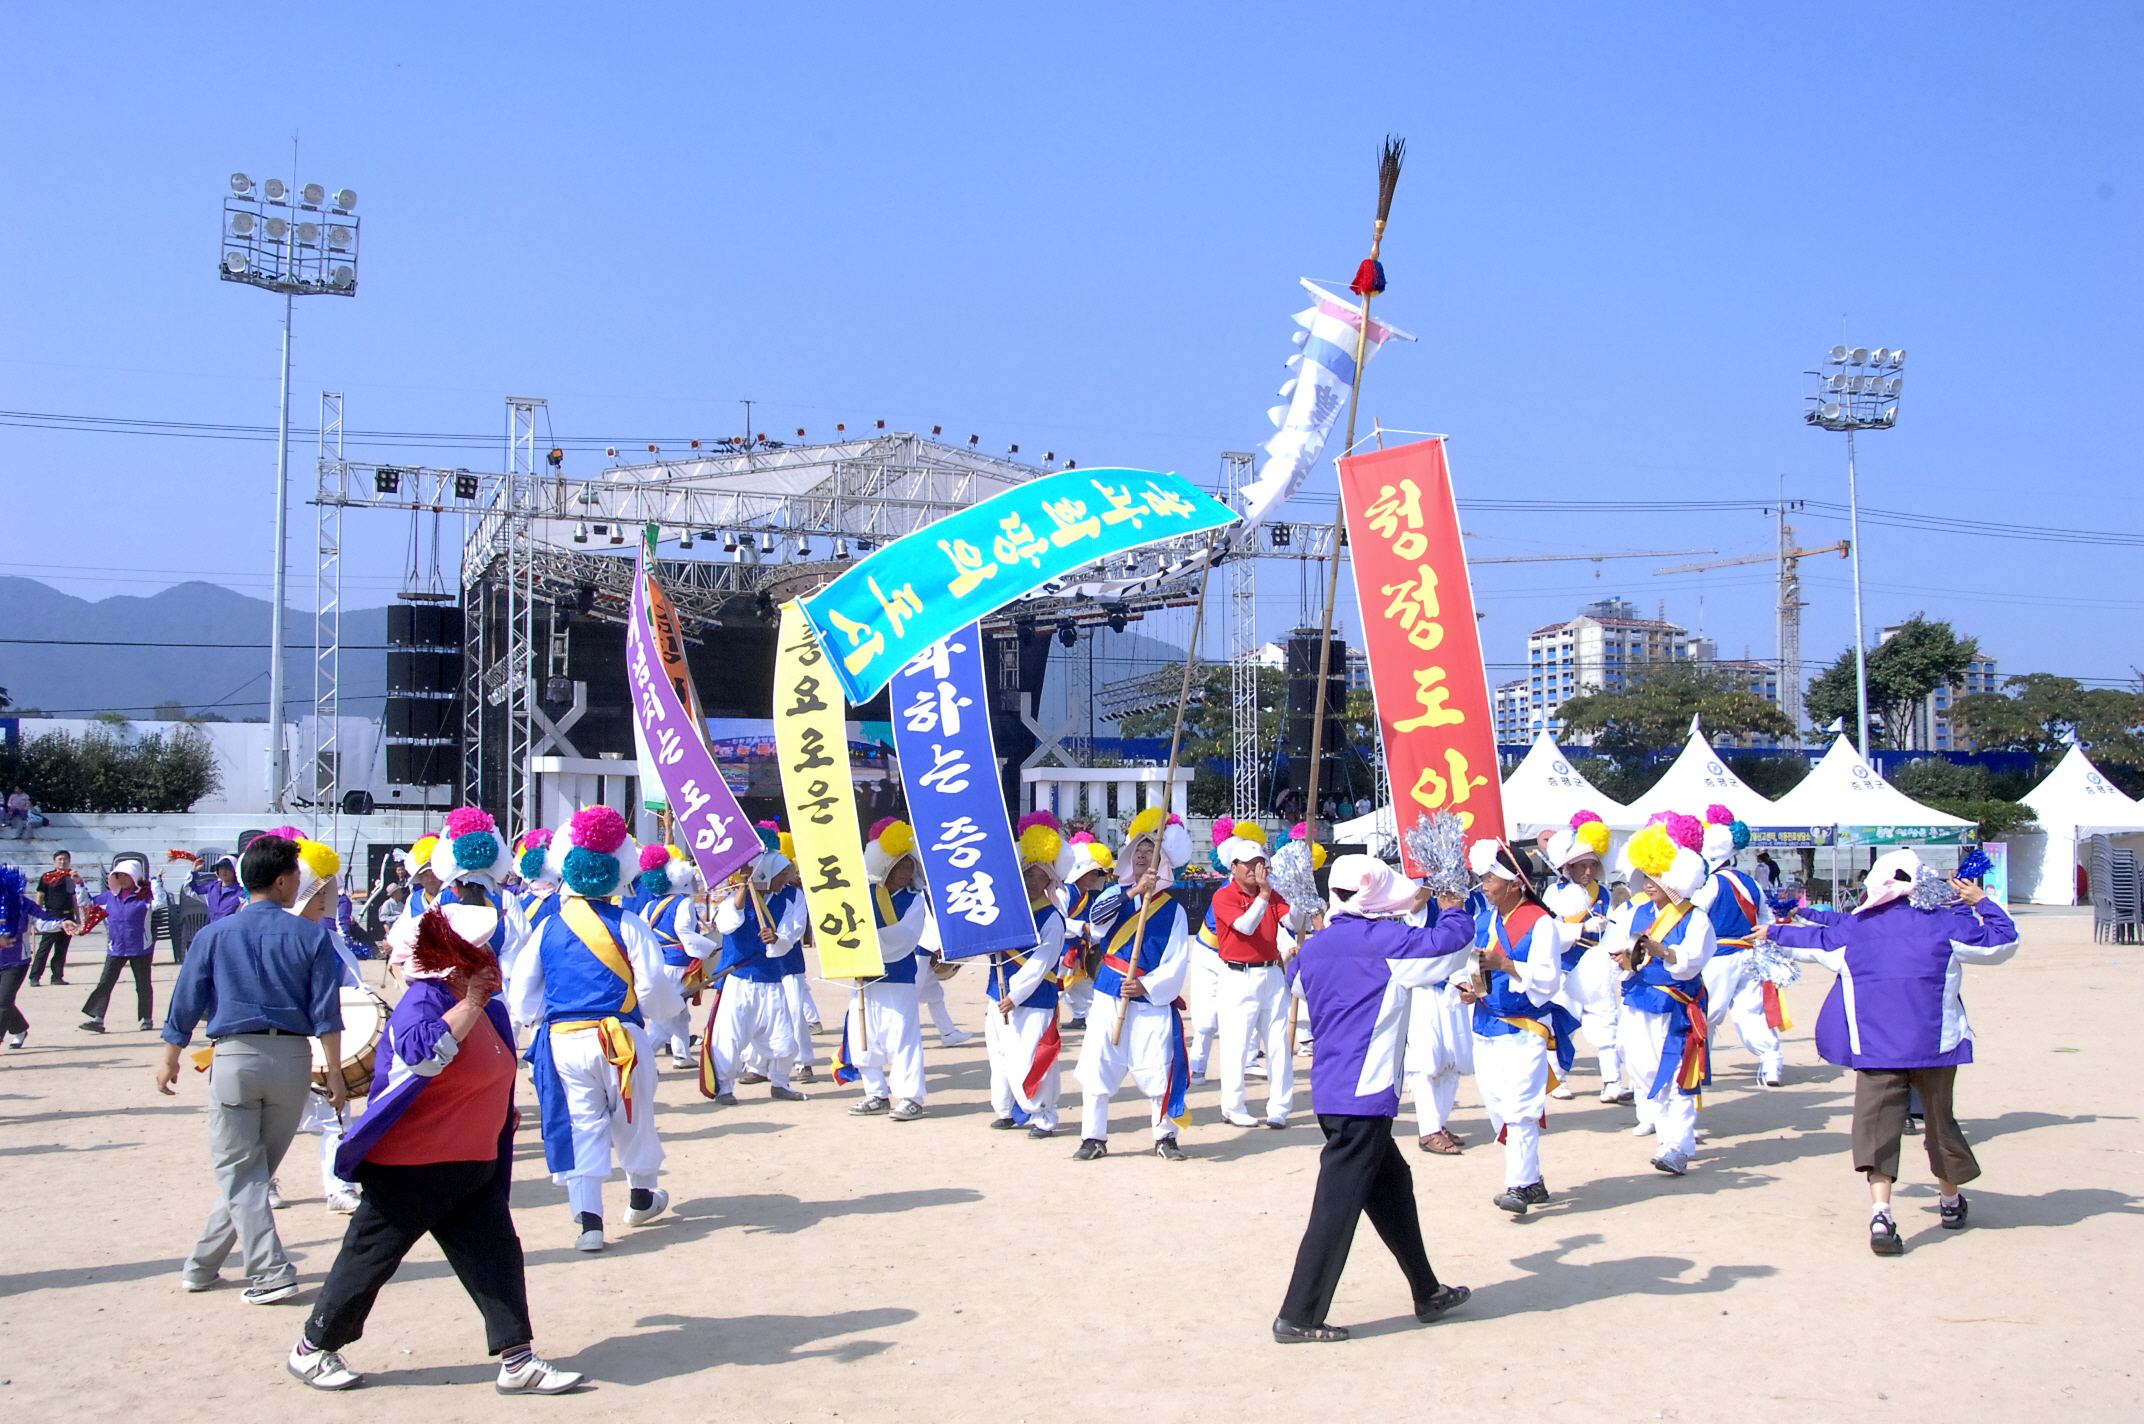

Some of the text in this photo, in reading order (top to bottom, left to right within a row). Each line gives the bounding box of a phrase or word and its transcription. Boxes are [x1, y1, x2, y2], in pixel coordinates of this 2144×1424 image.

[829, 575, 925, 676] 도시
[679, 779, 734, 854] 도안
[1547, 776, 1584, 787] 증평군
[1704, 778, 1739, 788] 증평군
[1851, 781, 1885, 791] 증평군
[810, 855, 866, 950] 도안
[932, 815, 1002, 926] 증평
